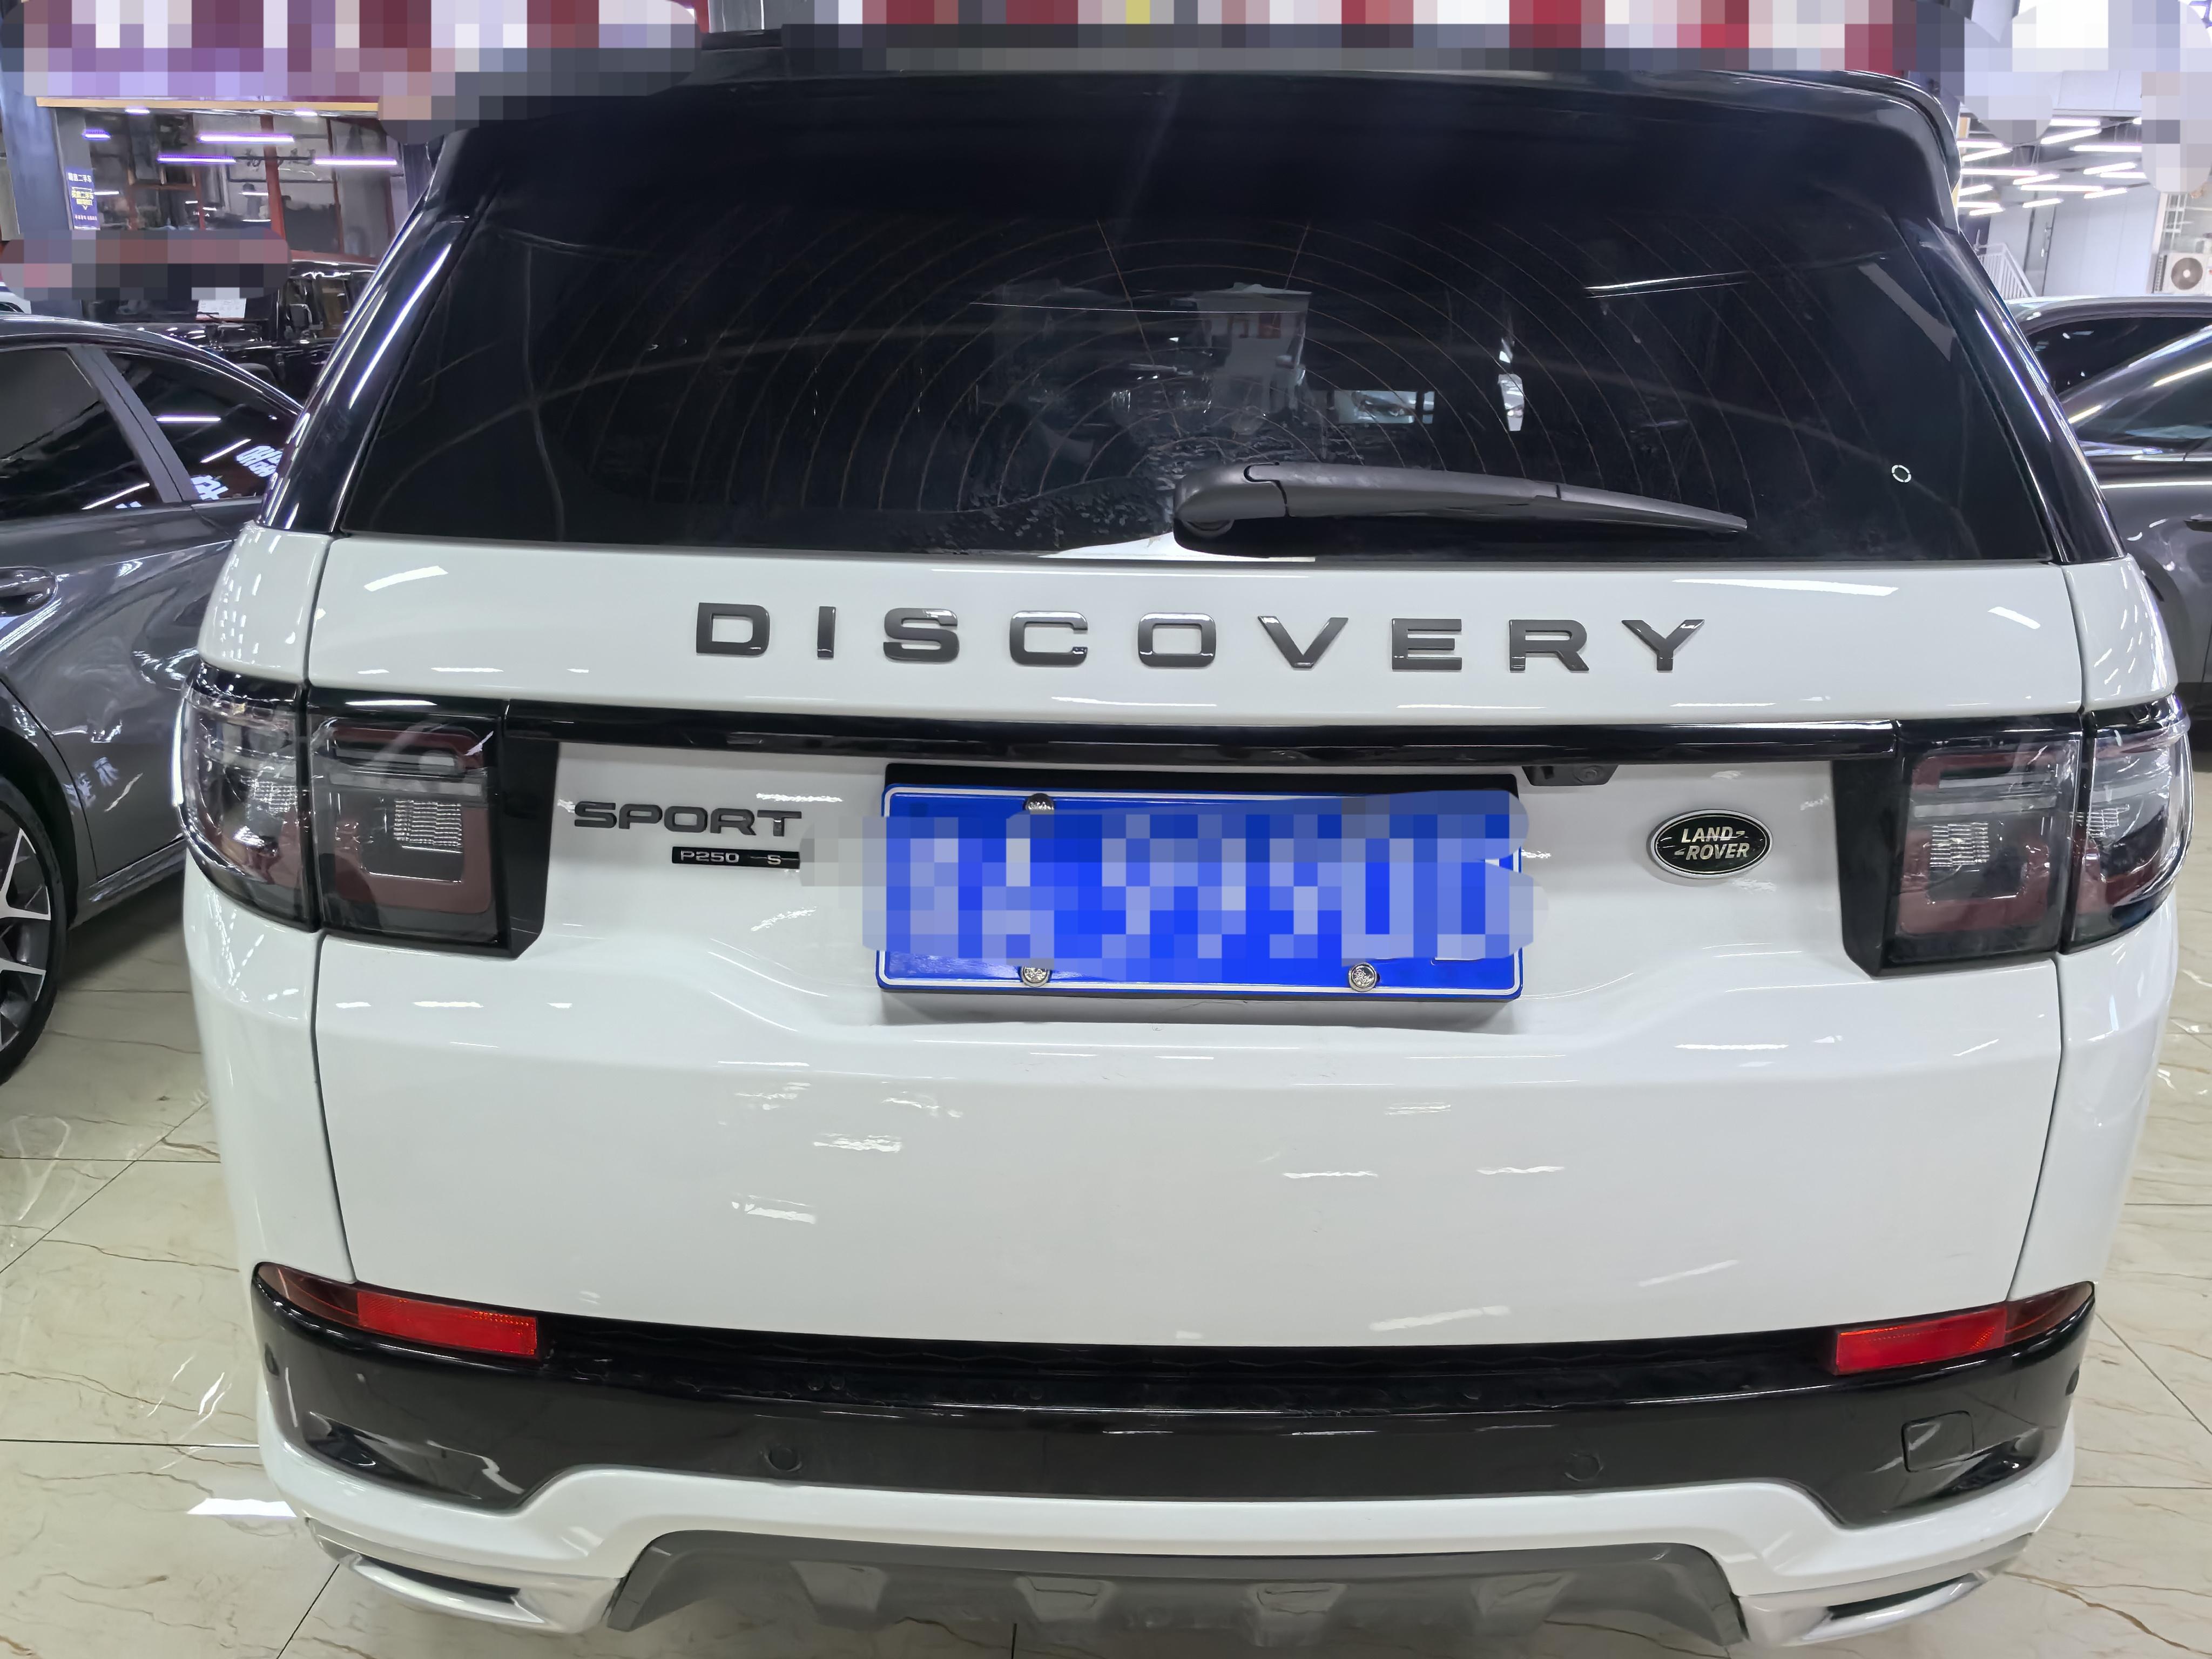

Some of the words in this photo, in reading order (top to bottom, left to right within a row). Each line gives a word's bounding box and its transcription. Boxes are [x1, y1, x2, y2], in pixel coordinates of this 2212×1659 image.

[696, 602, 1705, 672] DISCOVERY
[574, 801, 802, 837] SPORT
[1681, 826, 1734, 844] LAND
[680, 849, 740, 864] P250
[766, 854, 782, 865] S
[1685, 842, 1751, 861] ROVER
